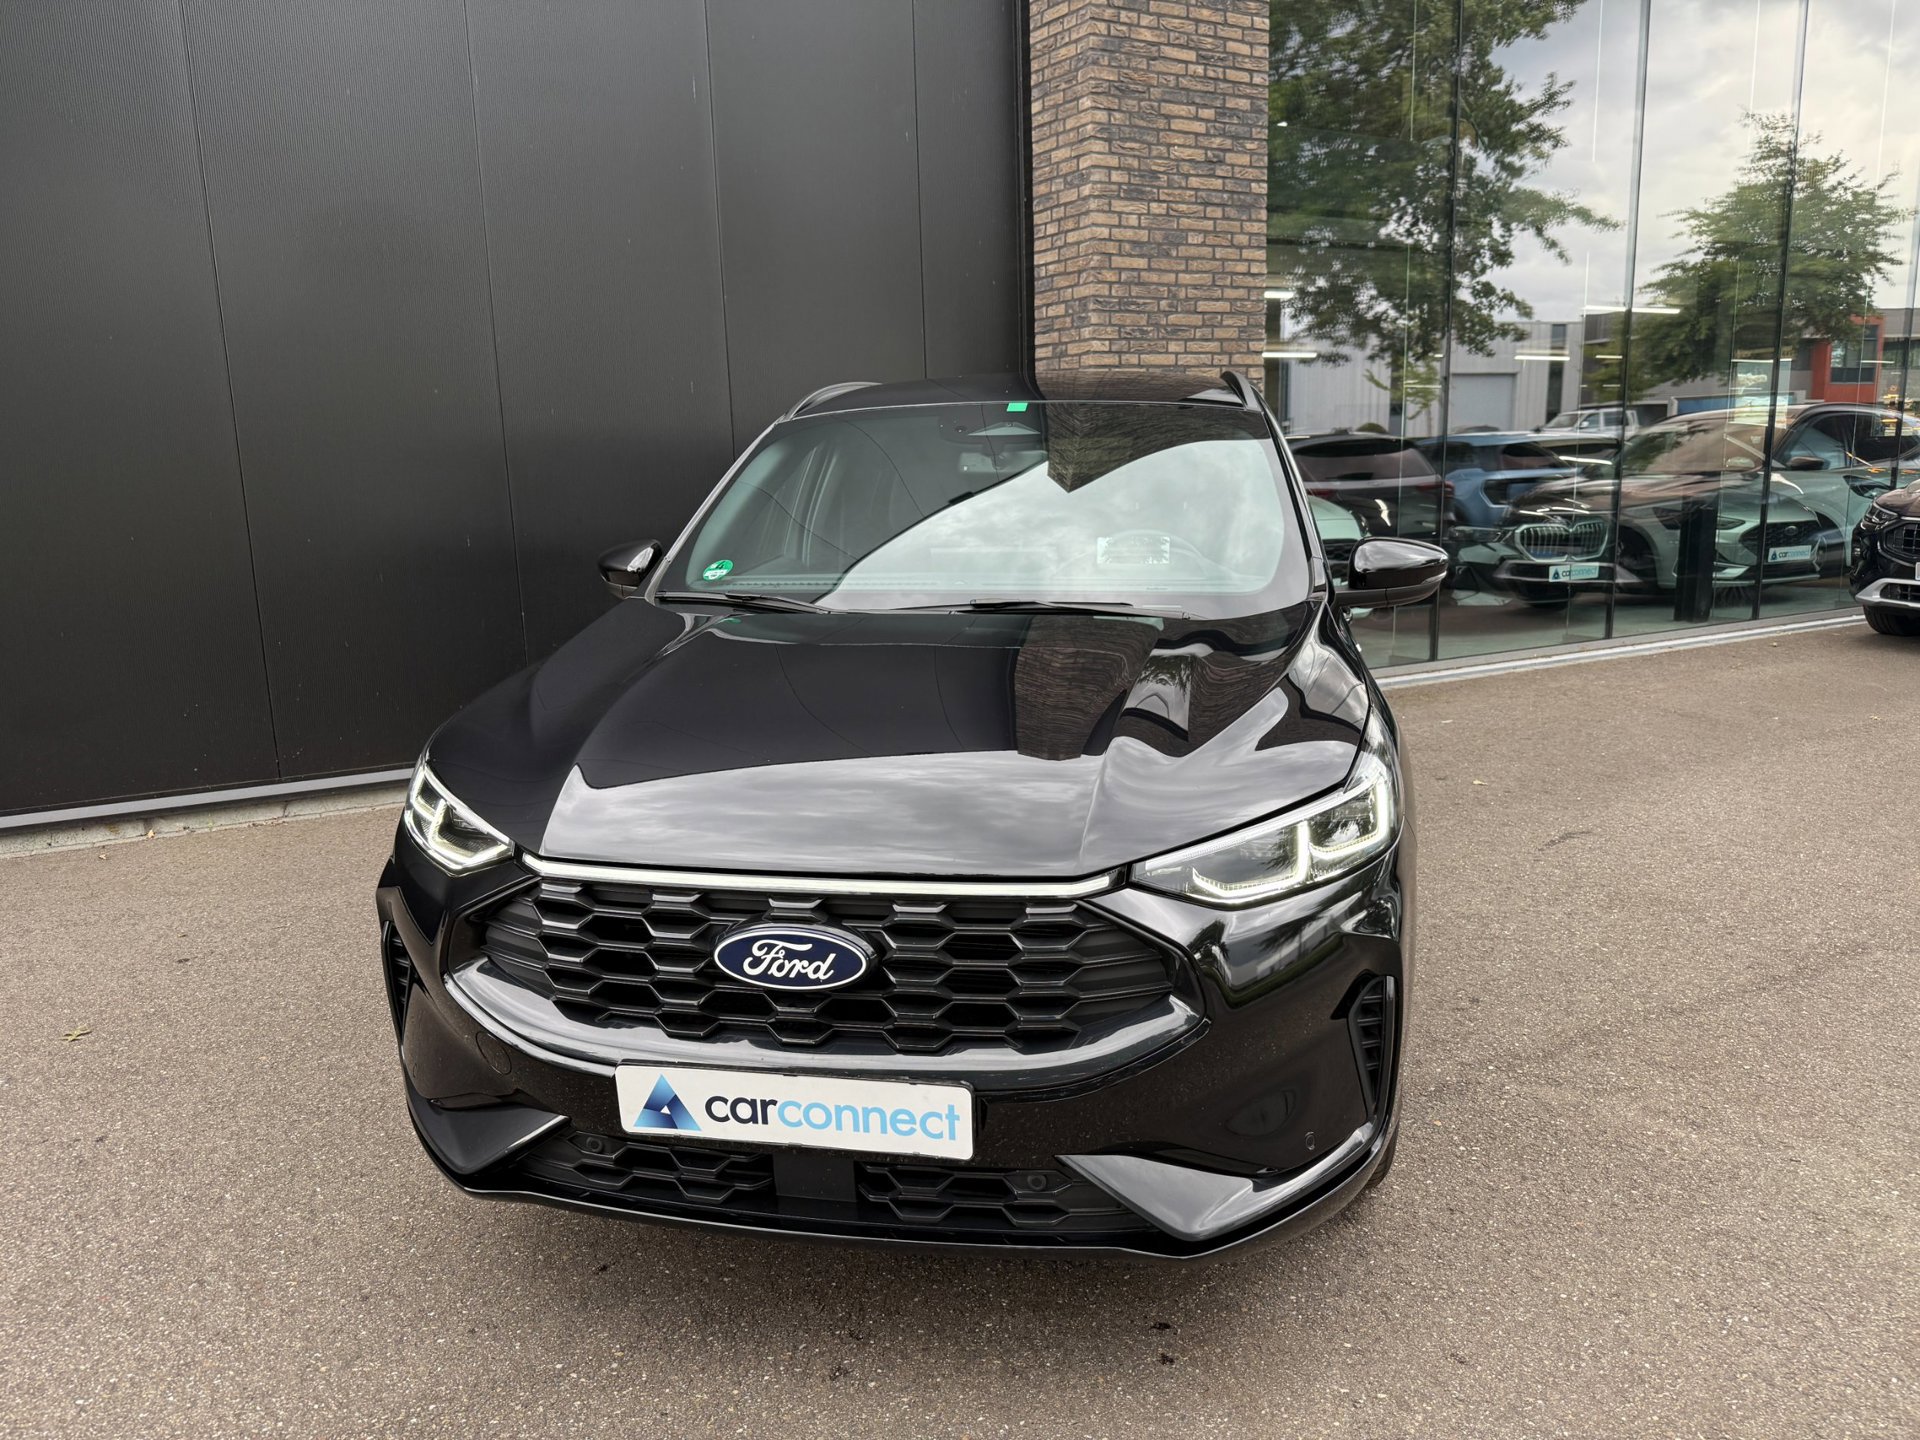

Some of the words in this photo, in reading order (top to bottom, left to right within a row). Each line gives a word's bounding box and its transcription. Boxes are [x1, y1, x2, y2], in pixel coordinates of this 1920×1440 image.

[1561, 567, 1597, 577] caconnect
[743, 939, 837, 981] Ford
[704, 1095, 961, 1141] carconnect
